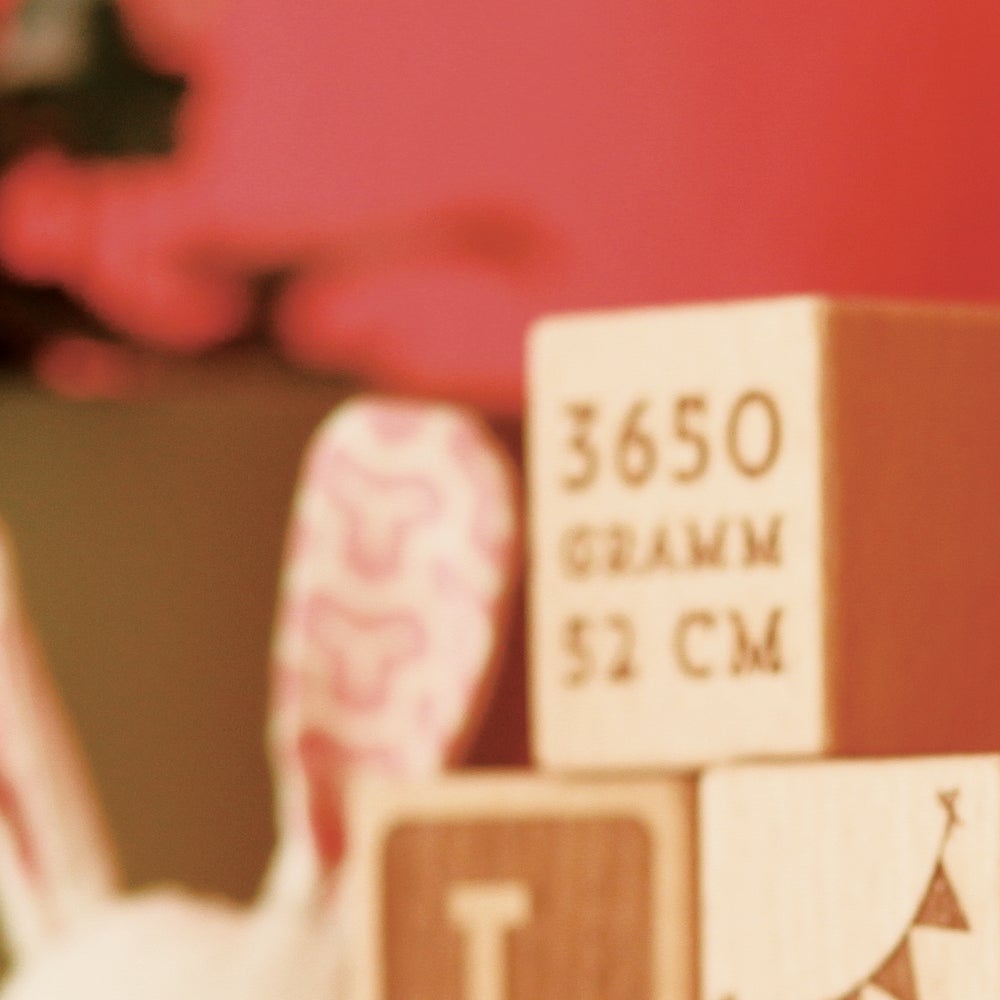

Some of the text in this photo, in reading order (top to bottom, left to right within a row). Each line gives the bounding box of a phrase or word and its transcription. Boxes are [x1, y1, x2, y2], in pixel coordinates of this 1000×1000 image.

[561, 388, 782, 492] 3650
[560, 514, 783, 580] GRAMM
[563, 607, 783, 688] 52 CM
